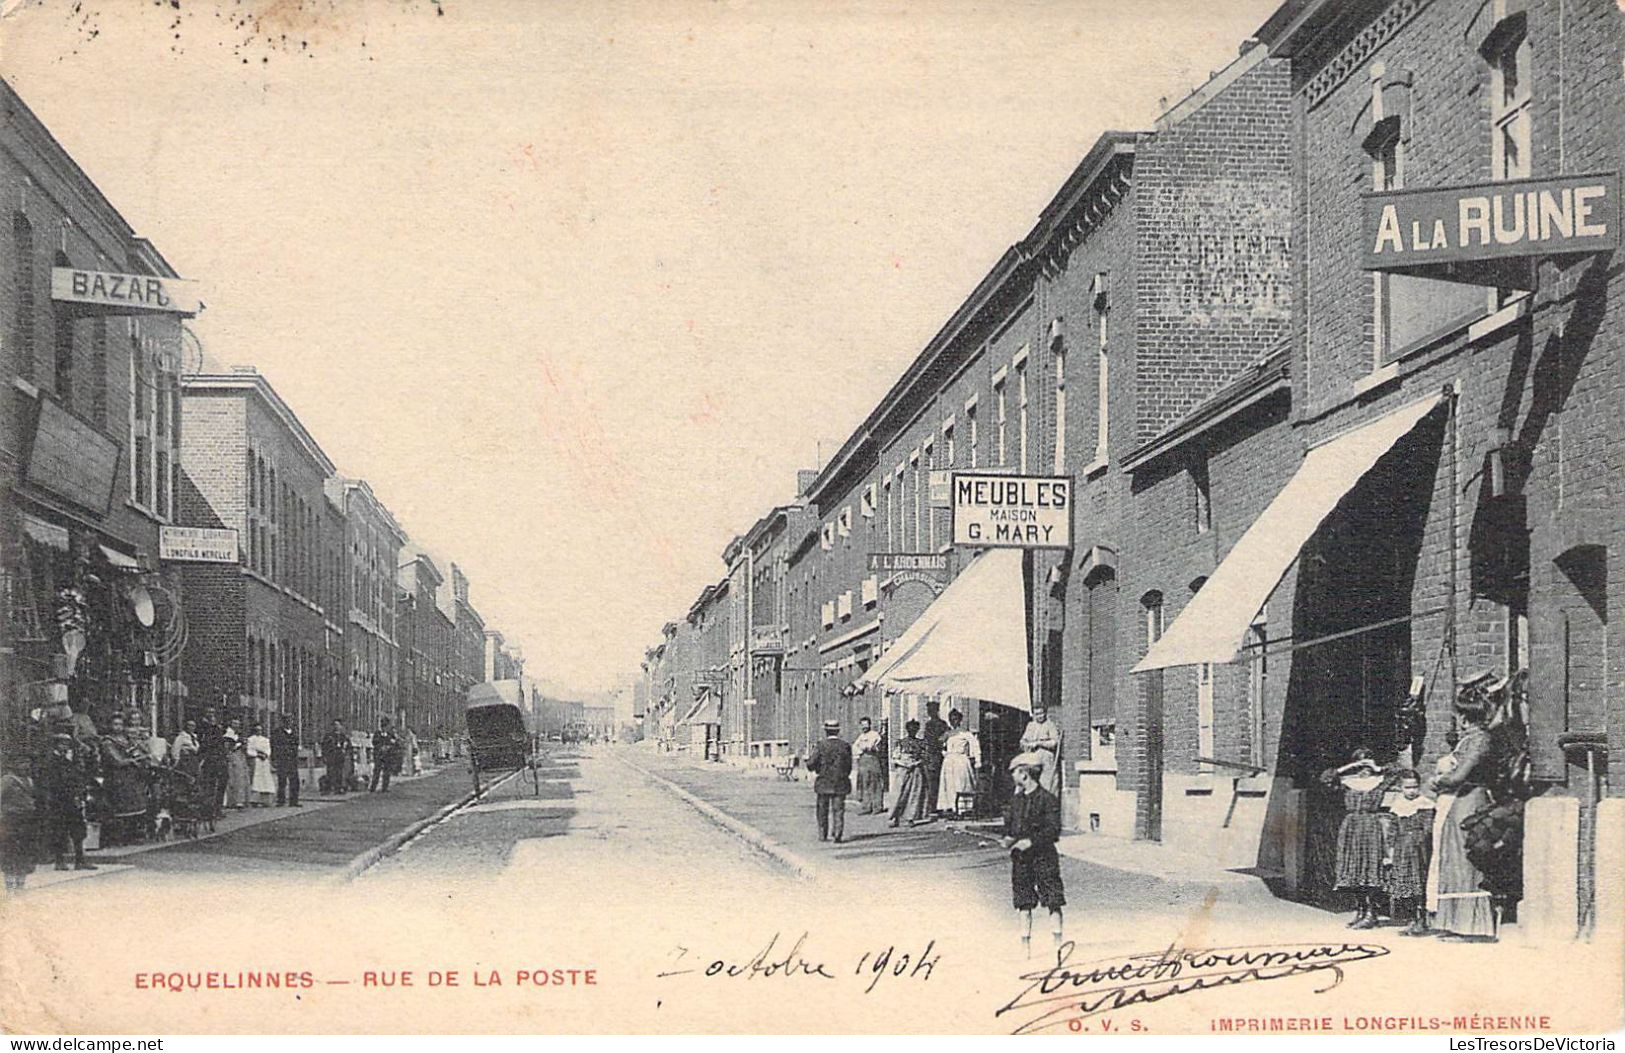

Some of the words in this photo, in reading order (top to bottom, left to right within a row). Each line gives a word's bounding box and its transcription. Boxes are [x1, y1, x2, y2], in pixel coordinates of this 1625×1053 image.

[1373, 204, 1403, 254] A
[1412, 219, 1448, 251] LA
[1459, 185, 1607, 248] RUINE
[71, 271, 170, 307] BAZAR
[958, 480, 1066, 507] MEUBLES
[990, 509, 1037, 522] MAISON
[968, 523, 990, 540] G.
[996, 523, 1053, 543] MARY
[855, 939, 941, 994] 1904
[135, 971, 314, 992] ERQUELINNES
[363, 971, 414, 987] RUE
[428, 971, 459, 987] DE
[473, 971, 502, 987] LA
[516, 969, 597, 986] POSTE
[1068, 1017, 1090, 1031] O.
[1101, 1018, 1120, 1031] V.
[1131, 1018, 1149, 1031] S.
[1211, 1017, 1333, 1032] IMPRIMERIE
